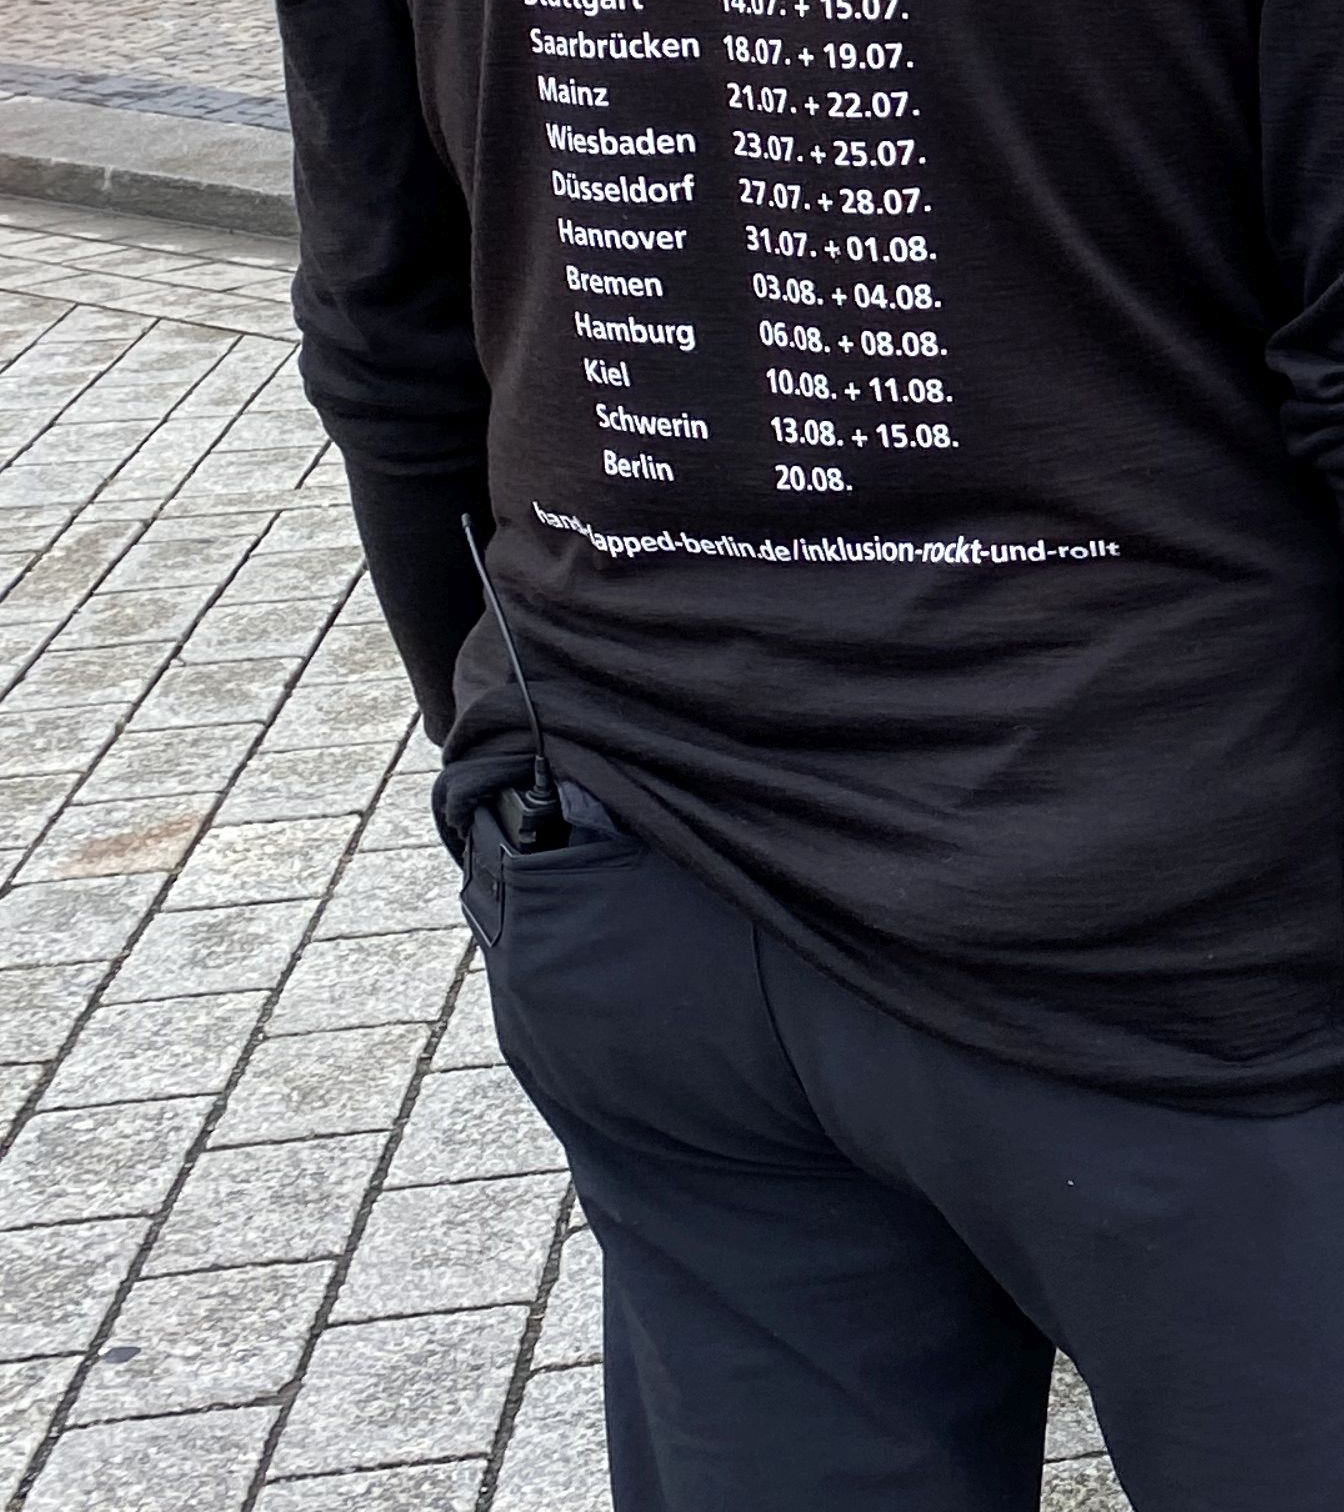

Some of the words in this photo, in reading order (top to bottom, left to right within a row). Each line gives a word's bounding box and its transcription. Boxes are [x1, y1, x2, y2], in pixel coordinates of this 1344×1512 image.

[529, 27, 701, 60] Saarbrücken
[722, 34, 791, 66] 18.07.
[797, 47, 815, 67] +
[823, 42, 914, 70] 19.07.
[537, 75, 610, 107] Mainz
[726, 82, 797, 114] 21.07.
[804, 96, 820, 116] +
[826, 90, 920, 118] 22.07.
[545, 122, 696, 156] Wiesbaden
[732, 130, 804, 163] 23.07.
[810, 144, 827, 165] +
[832, 139, 927, 167] 25.07.
[551, 169, 695, 204] Düsseldorf
[738, 177, 811, 211] 27.07.
[817, 192, 834, 212] +
[839, 187, 932, 215] 28.07.
[557, 217, 687, 251] Hannover
[745, 225, 817, 258] 31.07.
[824, 239, 842, 259] +
[846, 235, 937, 263] 01.08.
[565, 264, 664, 297] Bremen
[752, 272, 824, 306] 03.08.
[831, 287, 848, 306] +
[853, 282, 942, 311] 04.08.
[574, 310, 696, 352] Hamburg
[759, 320, 831, 353] 06.08.
[837, 335, 855, 354] +
[860, 330, 948, 357] 08.08.
[583, 357, 631, 387] Kiel
[766, 367, 837, 400] 10.08.
[844, 382, 861, 401] +
[868, 376, 953, 403] 11.08.
[595, 403, 709, 440] Schwerin
[770, 416, 844, 447] 13.08.
[851, 428, 868, 448] +
[875, 423, 959, 449] 15.08.
[603, 449, 675, 482] Berlin
[774, 464, 853, 492] 20.08.
